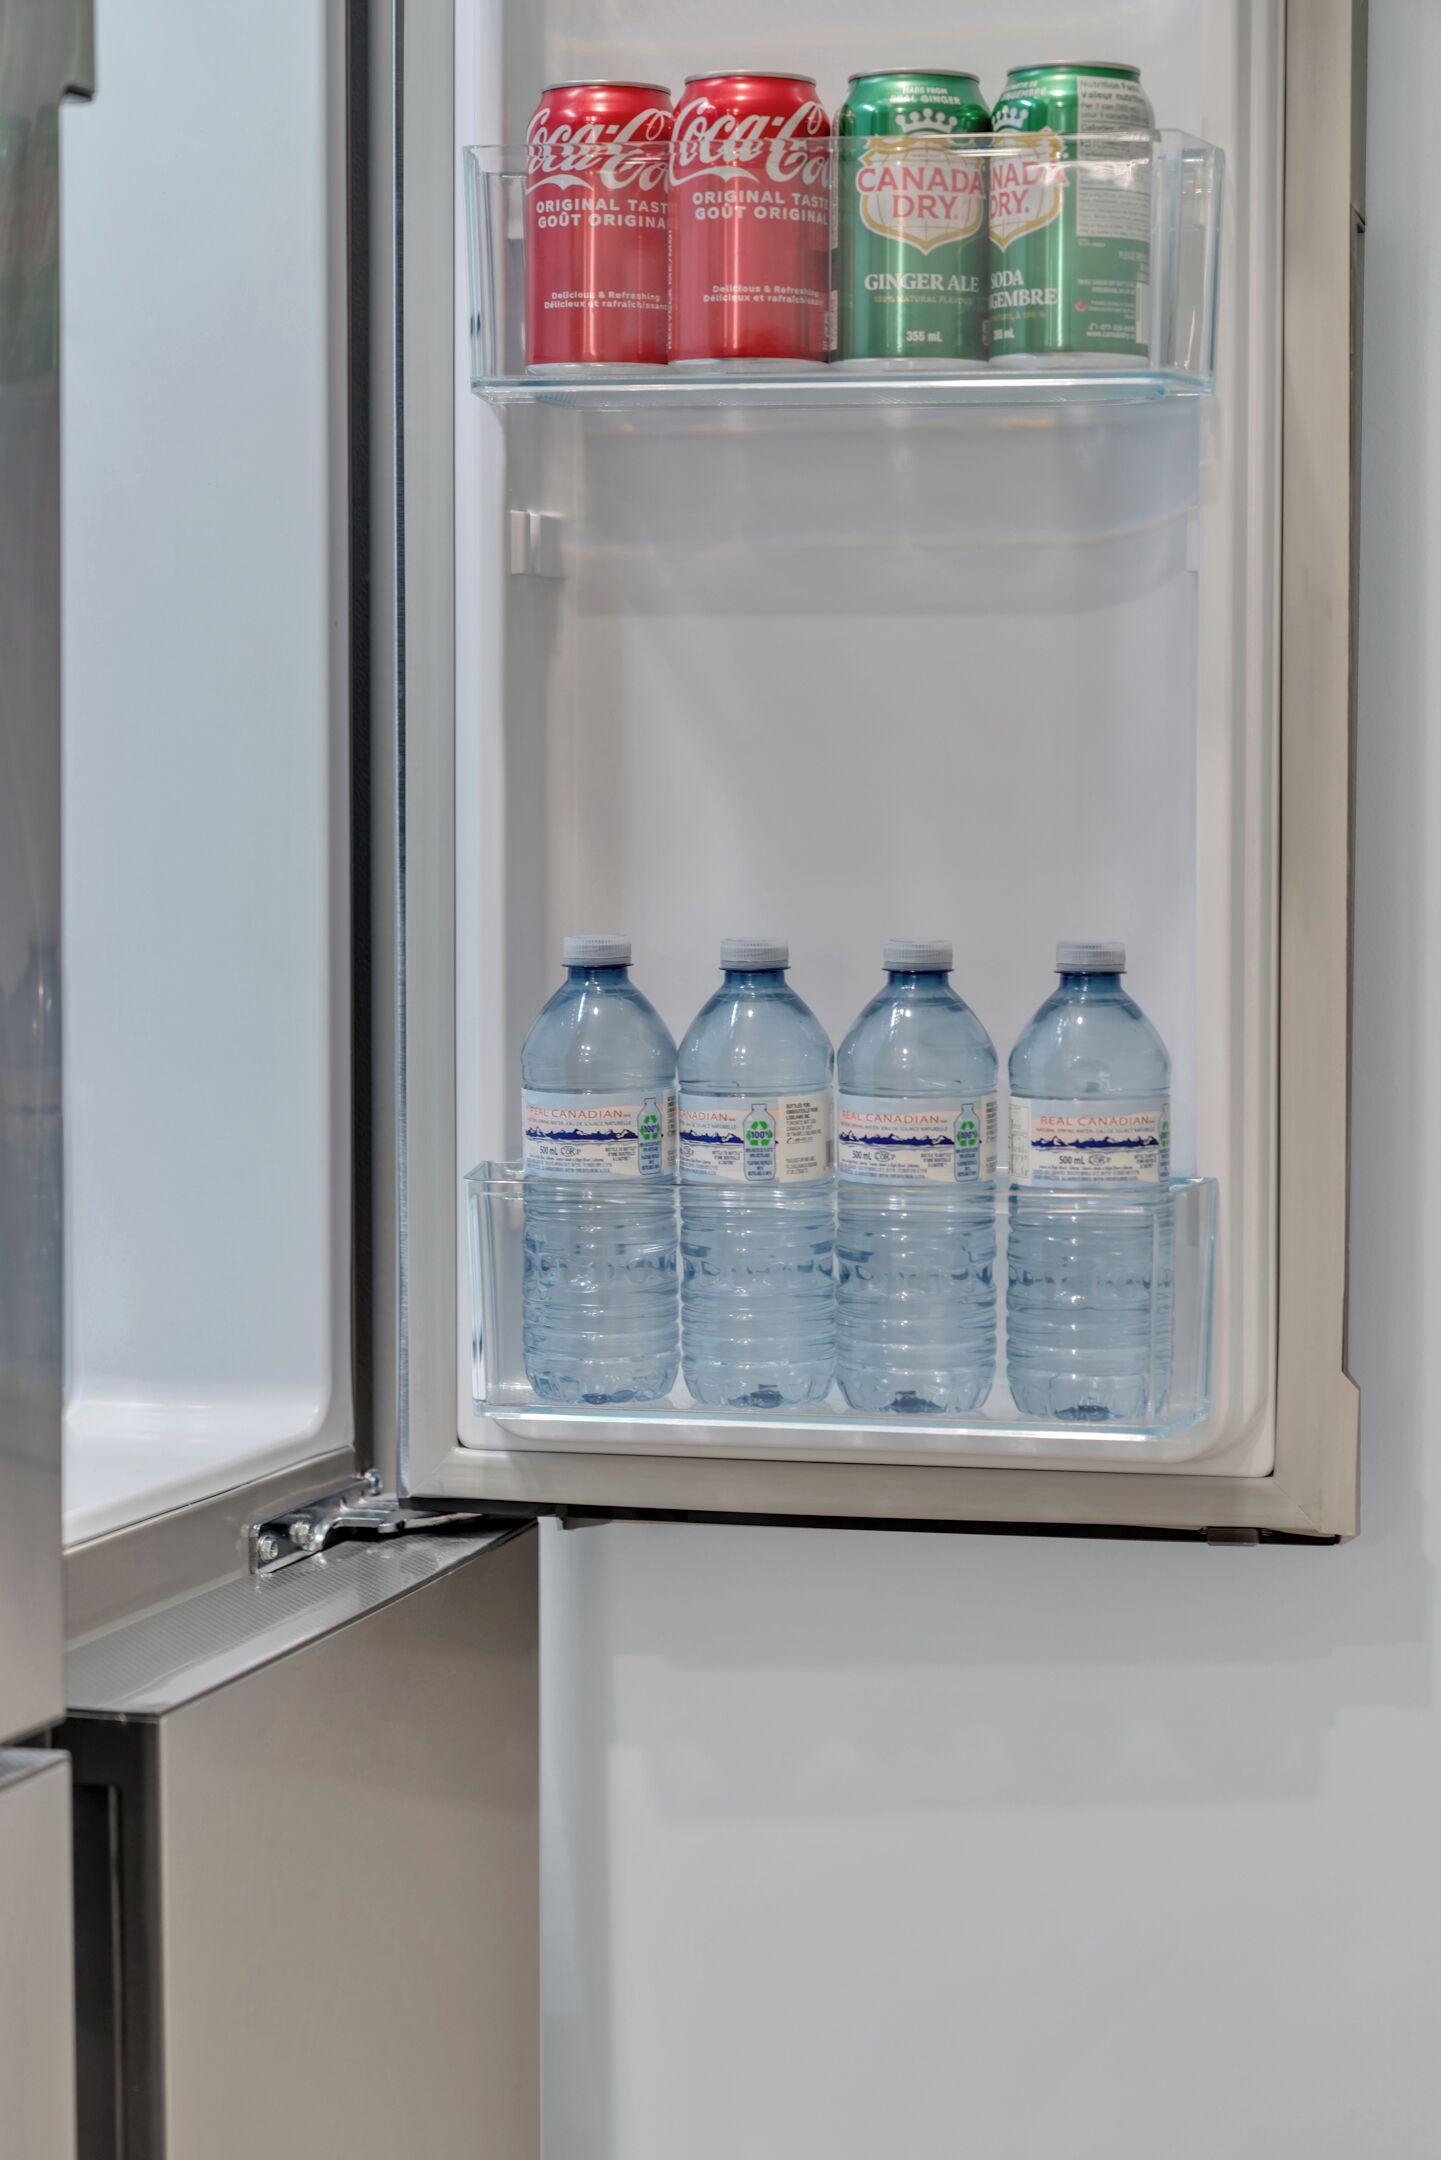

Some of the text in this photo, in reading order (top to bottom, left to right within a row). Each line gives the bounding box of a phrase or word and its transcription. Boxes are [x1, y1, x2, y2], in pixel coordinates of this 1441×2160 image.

[857, 167, 984, 196] CANADA
[990, 160, 1069, 192] NADA
[691, 190, 785, 205] ORIGINAL
[536, 198, 668, 215] ORIGINAL TAST
[695, 202, 828, 225] GOÛT ORIGINAL
[892, 194, 959, 220] DRY.
[538, 211, 666, 229] GOÛT ORIGINA
[712, 285, 755, 294] Delicious
[864, 273, 980, 293] GINGER ALE
[551, 290, 595, 299] Delicious
[608, 291, 660, 303] Refreshing
[989, 287, 1058, 309] GEMBRE
[906, 331, 943, 342] 355 mL
[551, 1109, 623, 1119] CANADIAN
[866, 1113, 940, 1124] CANADIAN
[1040, 1116, 1149, 1126] REAL CANADIAN
[852, 1151, 862, 1159] 500
[1059, 1156, 1085, 1165] 500 mL
